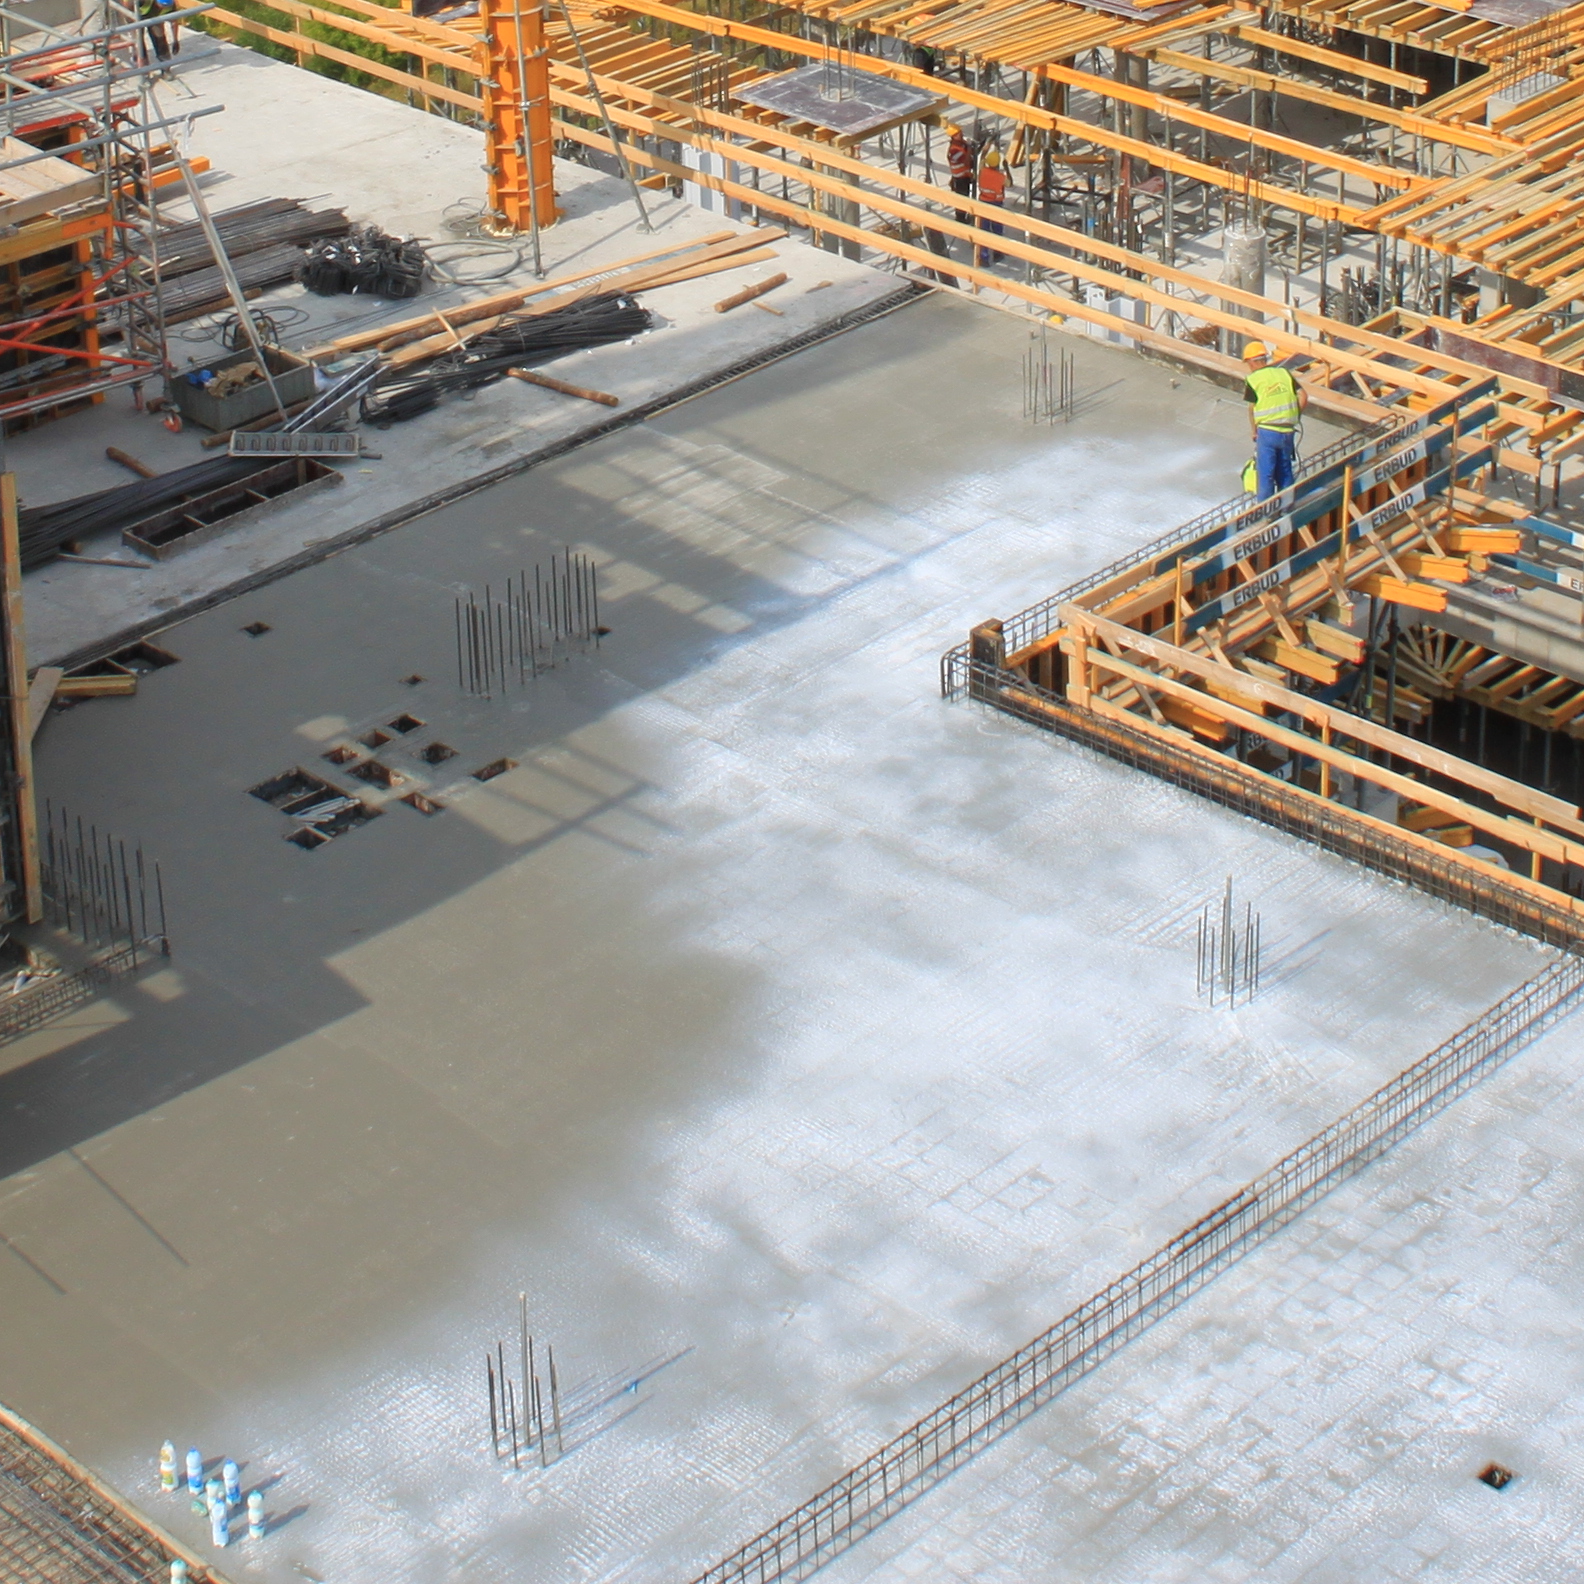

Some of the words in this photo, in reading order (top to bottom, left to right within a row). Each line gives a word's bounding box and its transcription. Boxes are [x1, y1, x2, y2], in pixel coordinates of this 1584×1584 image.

[1376, 421, 1419, 455] ERBUD
[1374, 448, 1416, 482] ERBUD
[1236, 497, 1282, 530] ERBUD
[1372, 493, 1414, 528] ERBUD
[1234, 526, 1281, 561] ERBUD
[1233, 571, 1279, 606] ERBUD
